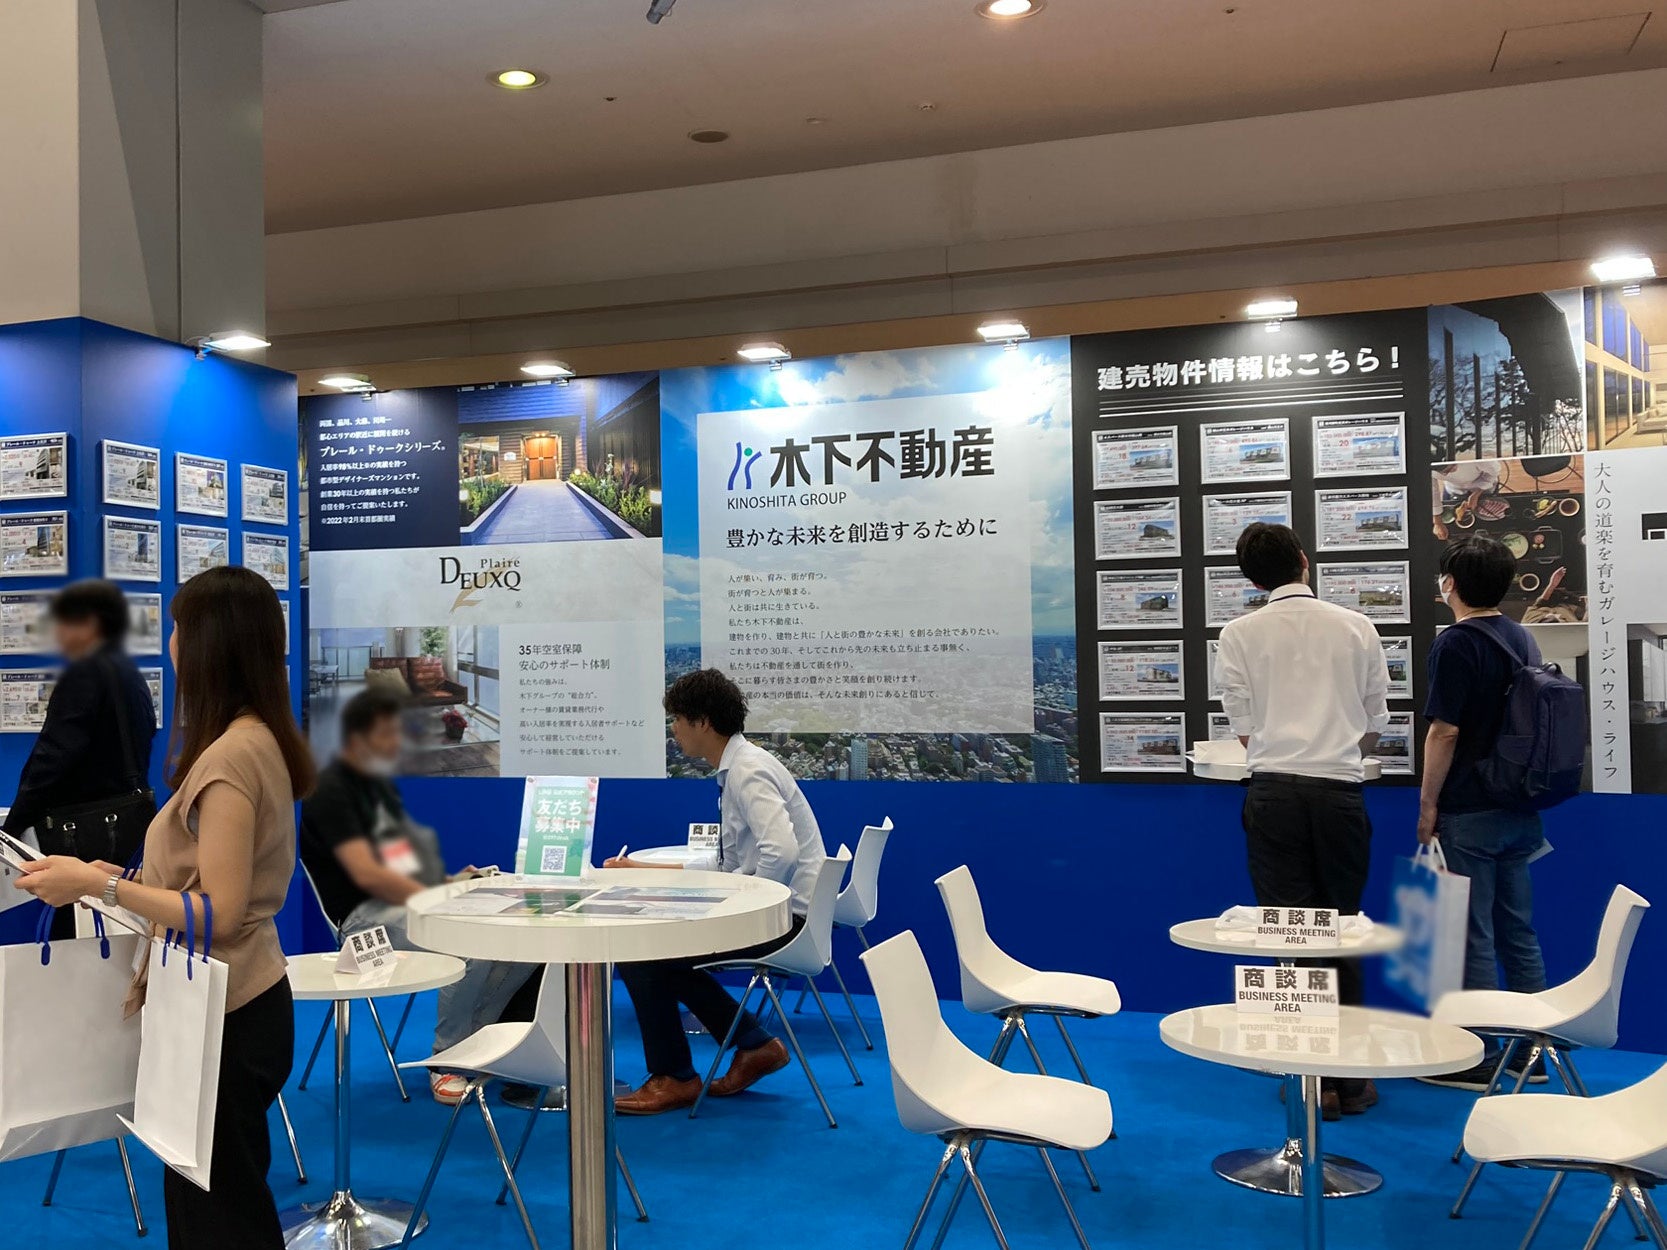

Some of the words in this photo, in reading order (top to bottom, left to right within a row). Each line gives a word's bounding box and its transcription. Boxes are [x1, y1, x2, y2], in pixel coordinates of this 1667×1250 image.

[1097, 346, 1399, 391] 建売物件情報はこちら！
[770, 425, 995, 488] 木下不動産
[727, 494, 797, 510] KINOSHITA
[800, 491, 847, 506] GROUP
[726, 518, 998, 548] 豊かな未来を創造するために
[480, 558, 520, 568] Plaire
[728, 572, 828, 583] 人が集い、育み、街が育つ。
[728, 587, 811, 598] 街が育つと人が集まる。
[728, 602, 820, 612] 人と街は共に生きている。
[729, 617, 804, 627] 私たち木下不動産は、
[1594, 462, 1617, 779] 大人の道楽を育むガレージハウス・ライフ
[519, 644, 582, 655] 35年空室保障
[519, 659, 610, 671] 安心のサポート体制
[729, 660, 854, 671] 私たちは不動産を通して街を作り、
[536, 799, 582, 816] 友だち
[535, 816, 580, 833] 募集中
[1263, 909, 1331, 926] 商談席
[1257, 927, 1297, 936] BUSINESS
[1299, 929, 1336, 938] MEETING
[351, 928, 387, 953] 商談席
[1243, 968, 1329, 990] 商談席
[1239, 991, 1288, 1001] BUSINESS
[1291, 993, 1337, 1004] MEETING
[1274, 1003, 1302, 1012] AREA
